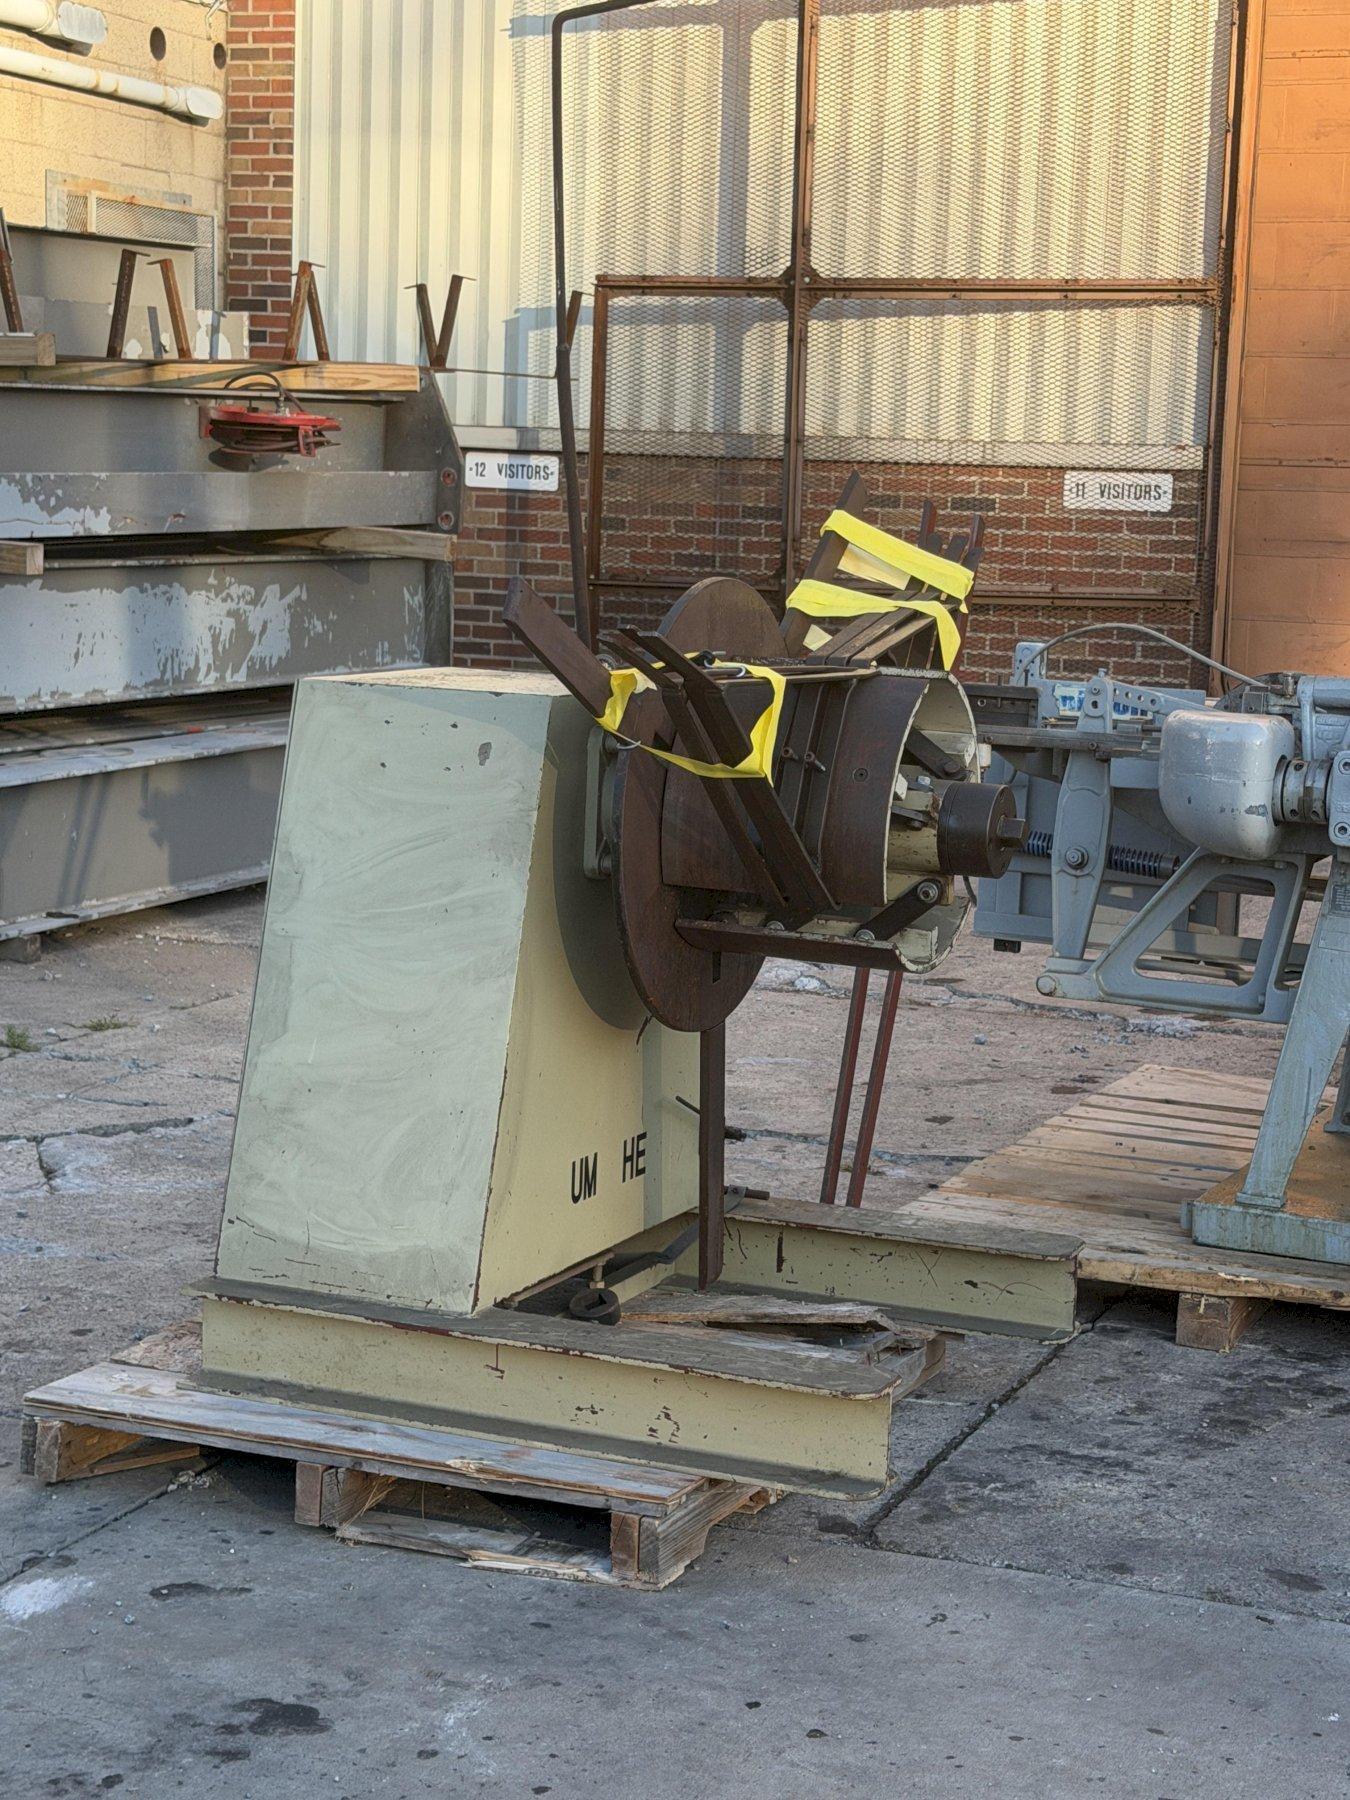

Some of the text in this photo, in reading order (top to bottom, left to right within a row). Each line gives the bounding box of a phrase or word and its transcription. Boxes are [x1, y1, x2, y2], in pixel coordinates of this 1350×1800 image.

[475, 462, 550, 480] 12 VISITORS
[1075, 482, 1162, 500] 11 VISITORS
[571, 1131, 647, 1204] UM HE
